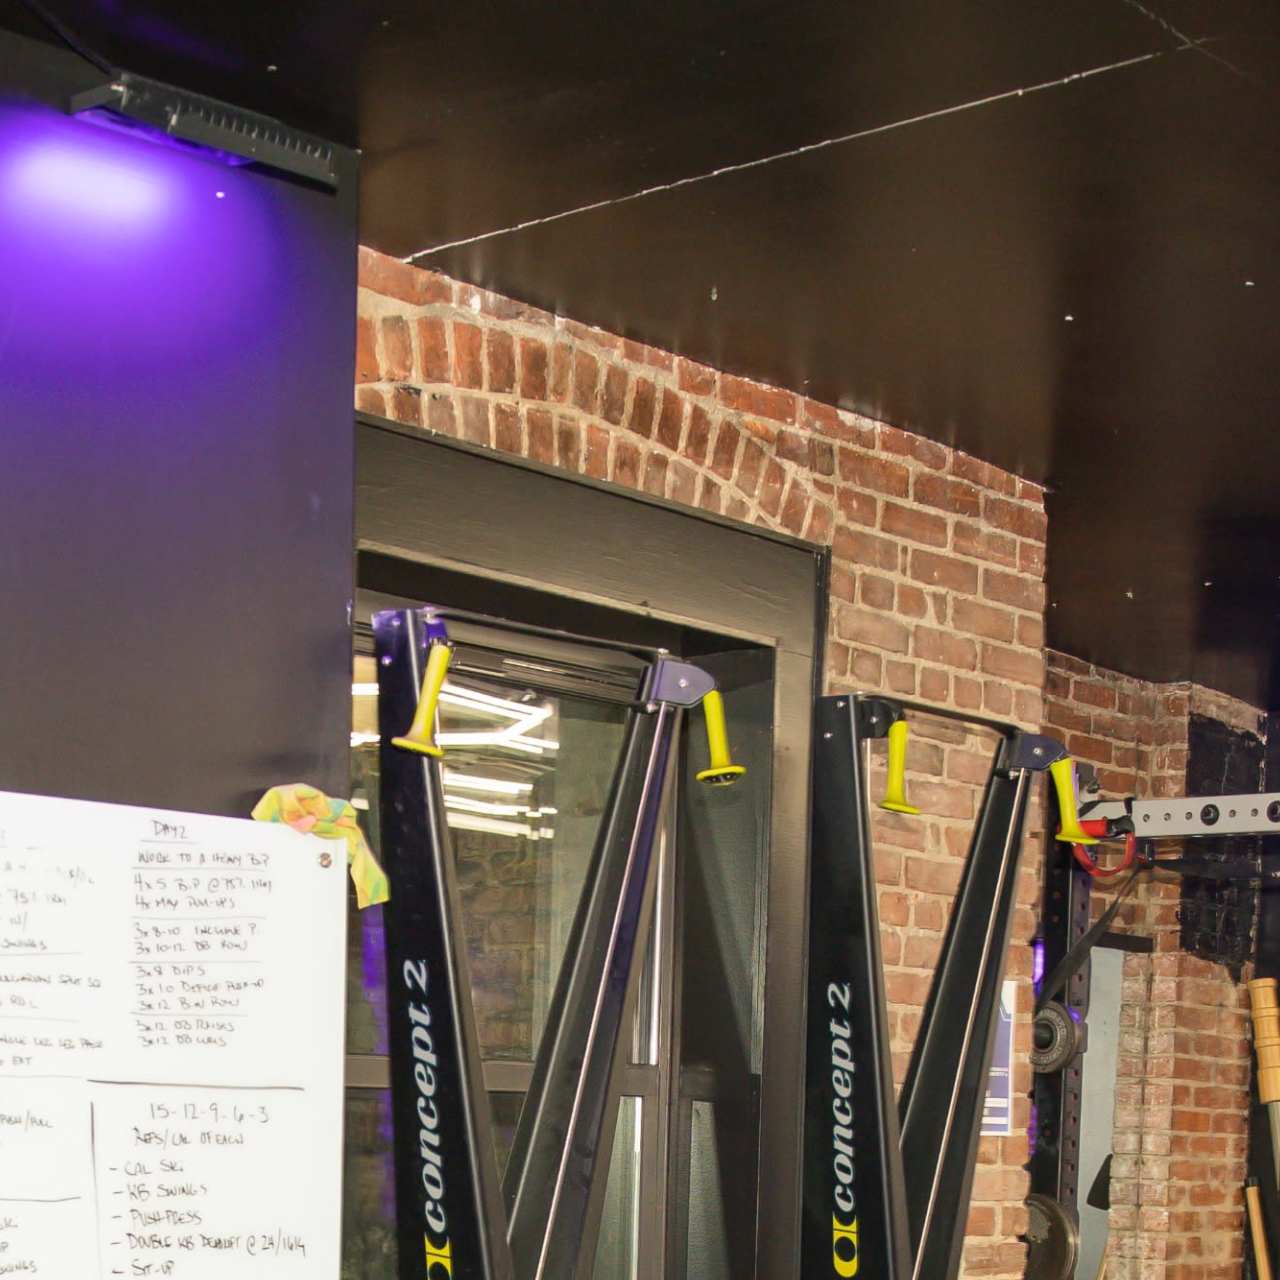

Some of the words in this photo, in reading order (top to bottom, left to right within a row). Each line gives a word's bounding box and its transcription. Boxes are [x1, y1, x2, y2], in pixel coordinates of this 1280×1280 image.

[403, 959, 428, 997] 2
[827, 982, 851, 1011] 2
[408, 1002, 447, 1234] concept
[829, 1018, 856, 1214] concept
[124, 1160, 154, 1176] CAL
